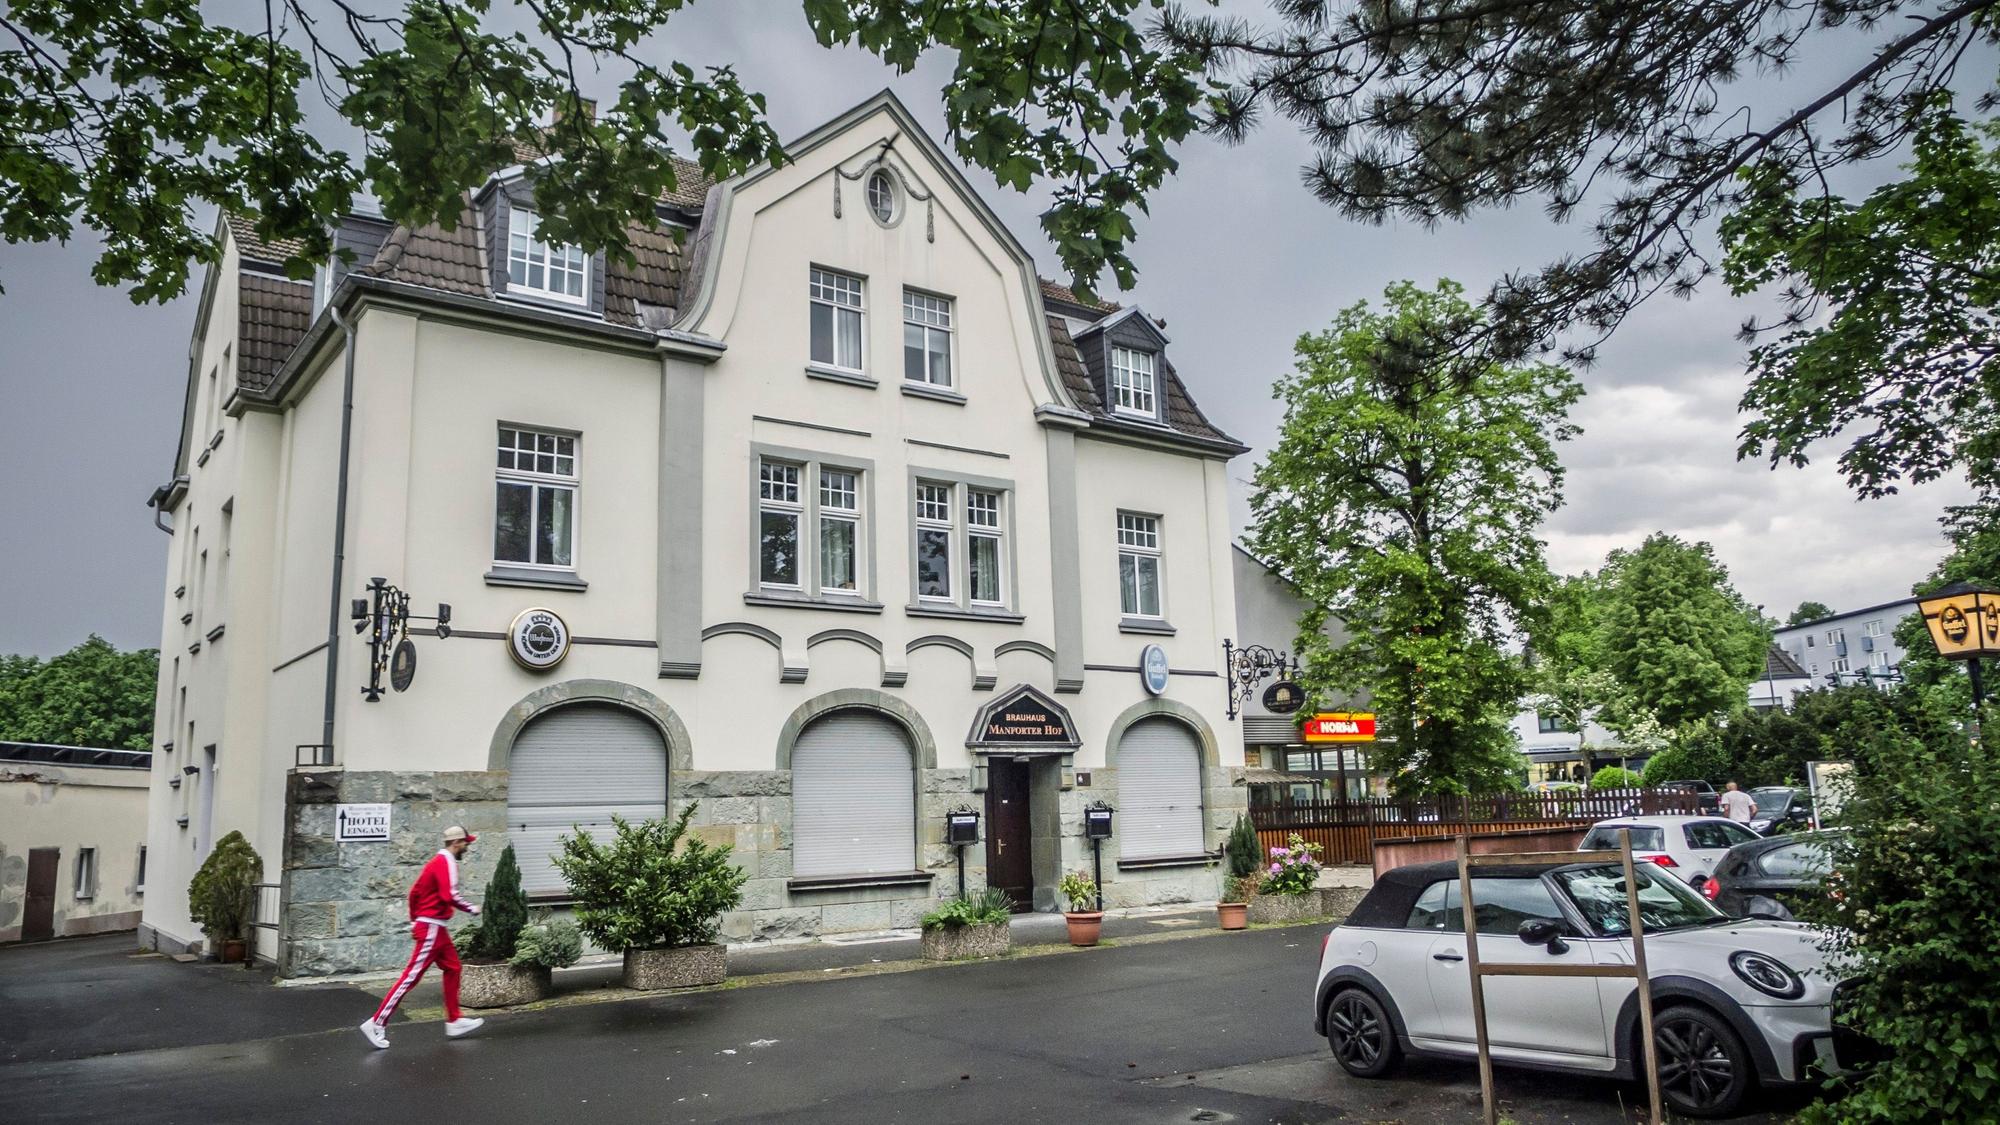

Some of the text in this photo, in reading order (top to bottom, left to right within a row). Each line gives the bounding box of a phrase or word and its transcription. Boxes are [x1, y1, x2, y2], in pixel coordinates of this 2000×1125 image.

[1005, 713, 1046, 722] BRAUHAUS
[989, 724, 1063, 736] MANFORTER HOF
[347, 816, 388, 826] HOTEL
[347, 827, 387, 835] EINGANG
